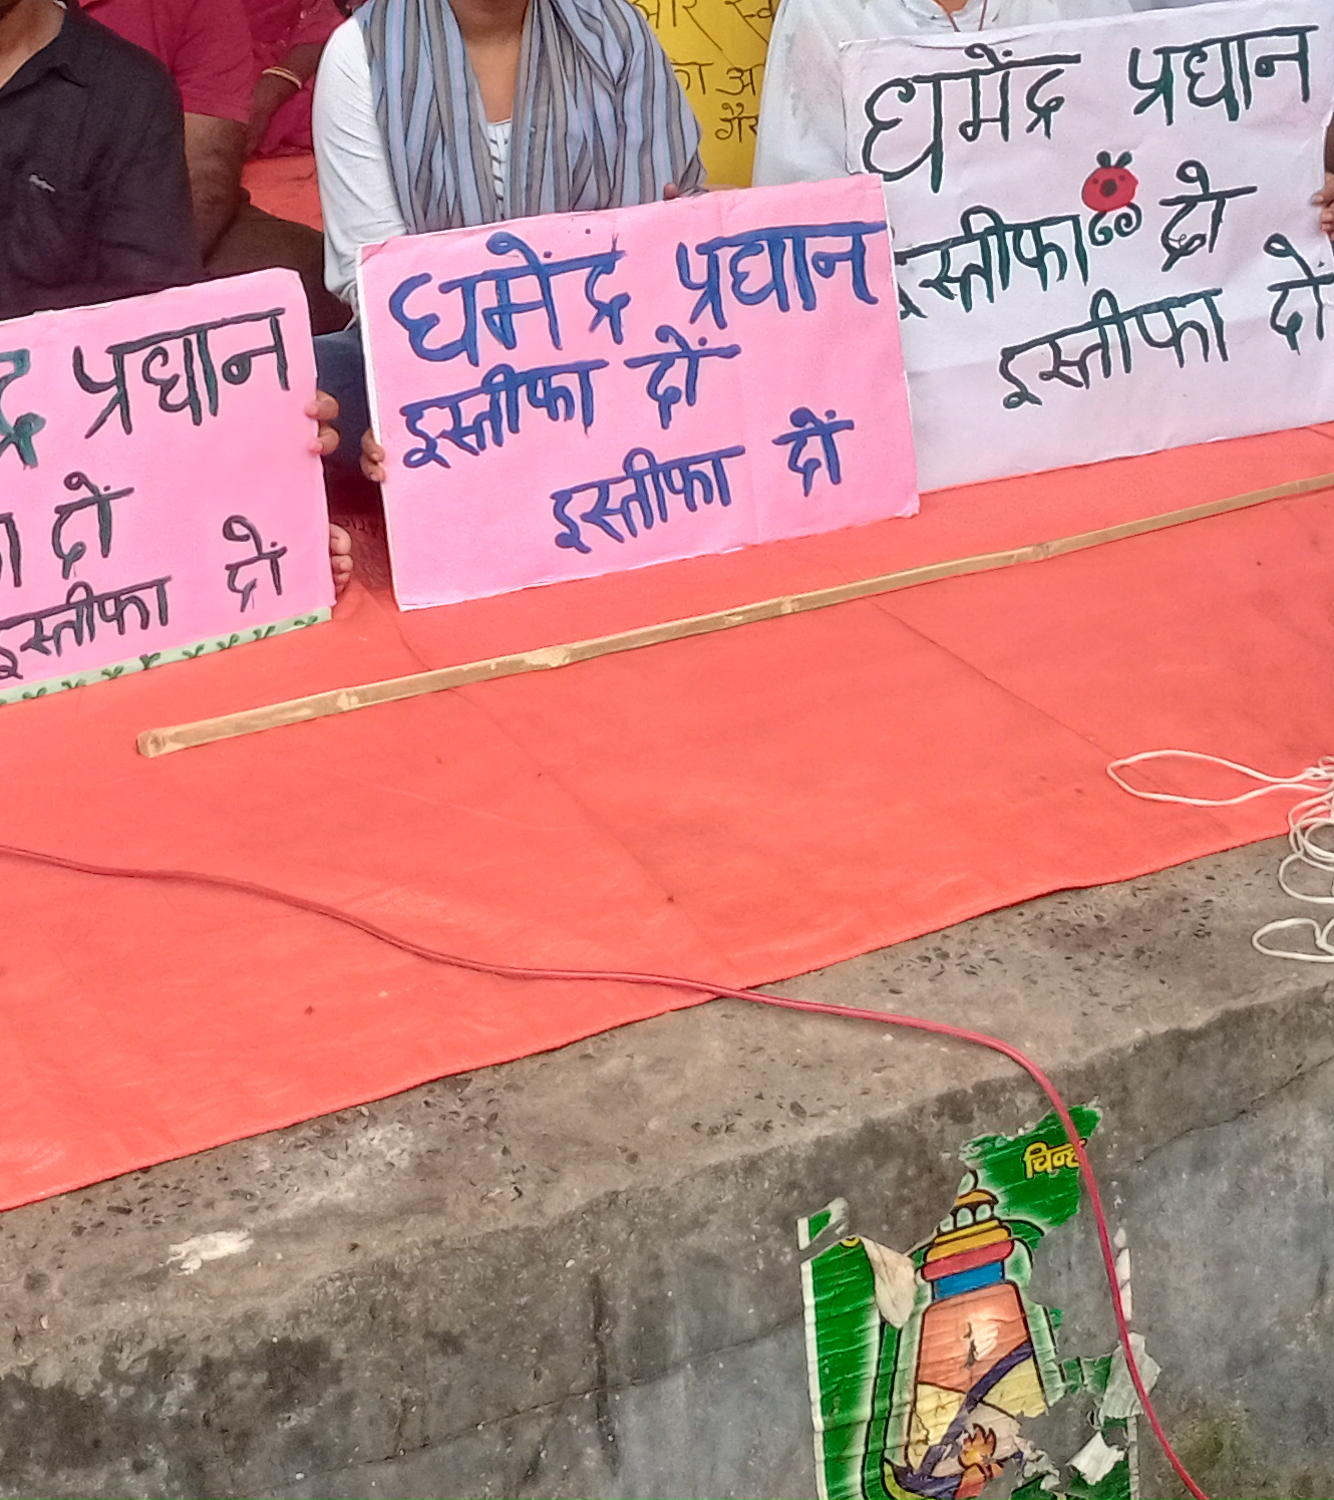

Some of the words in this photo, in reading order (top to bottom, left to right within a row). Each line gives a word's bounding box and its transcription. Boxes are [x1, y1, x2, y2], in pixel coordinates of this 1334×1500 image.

[1159, 160, 1258, 272] दो
[72, 307, 290, 439] प्रधान
[999, 288, 1229, 409] इस्तीफा
[399, 360, 609, 469] इस्तीफा
[550, 447, 745, 554] इस्तीफा
